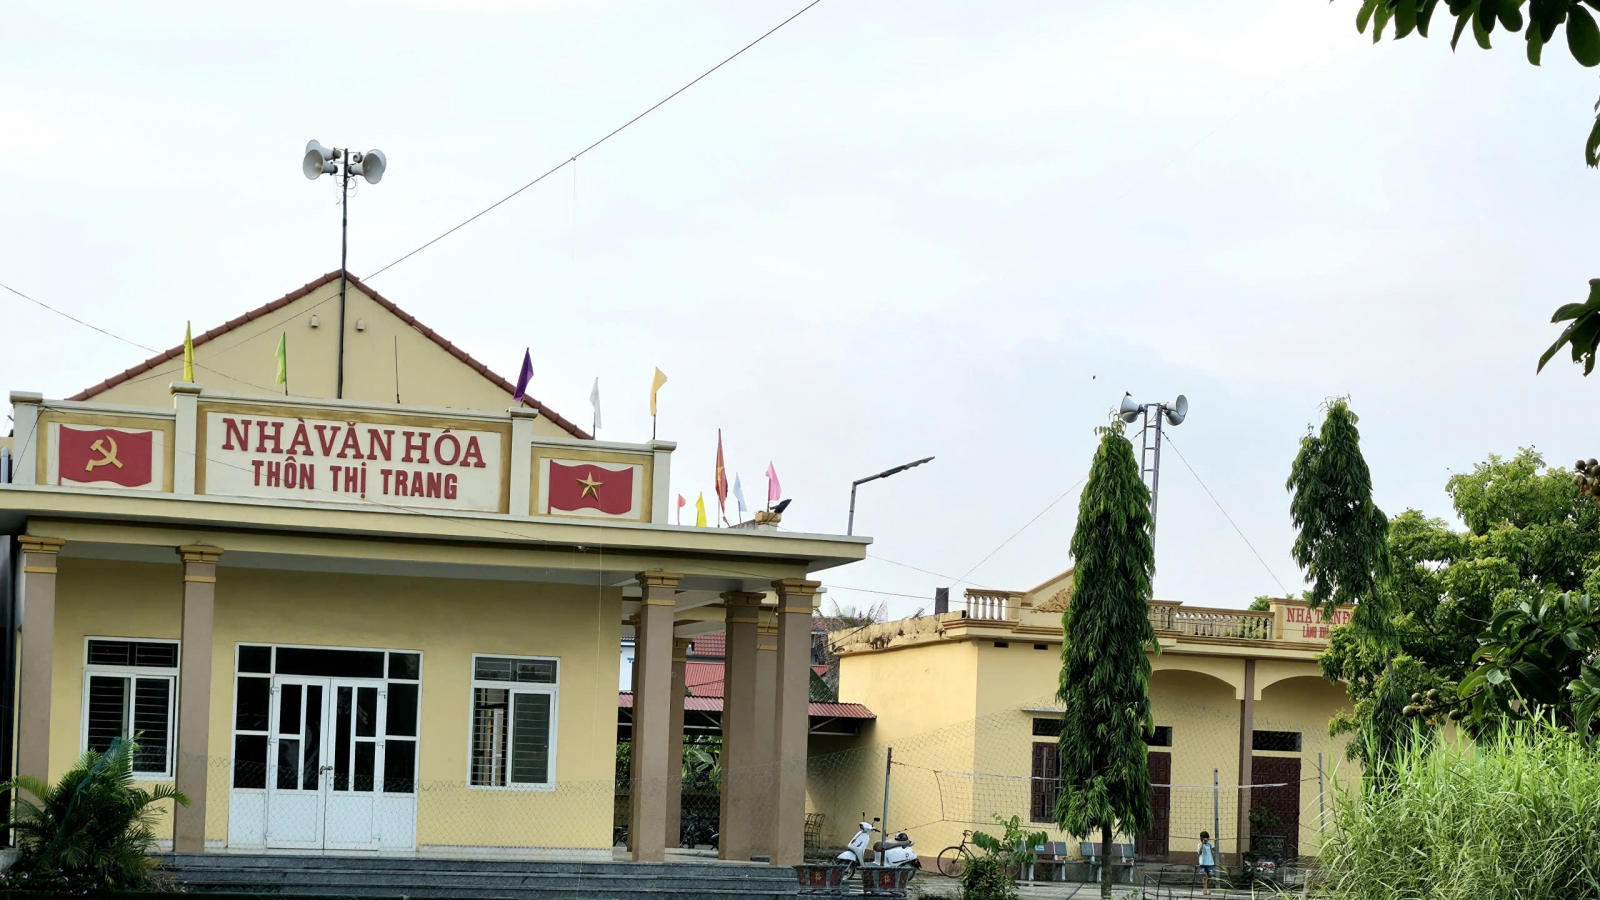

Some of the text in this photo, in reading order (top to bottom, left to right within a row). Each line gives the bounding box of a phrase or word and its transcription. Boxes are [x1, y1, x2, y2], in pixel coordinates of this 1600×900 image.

[222, 416, 486, 468] NHÀ VĂN HÓA
[251, 455, 458, 500] THÔN THỊ TRANG
